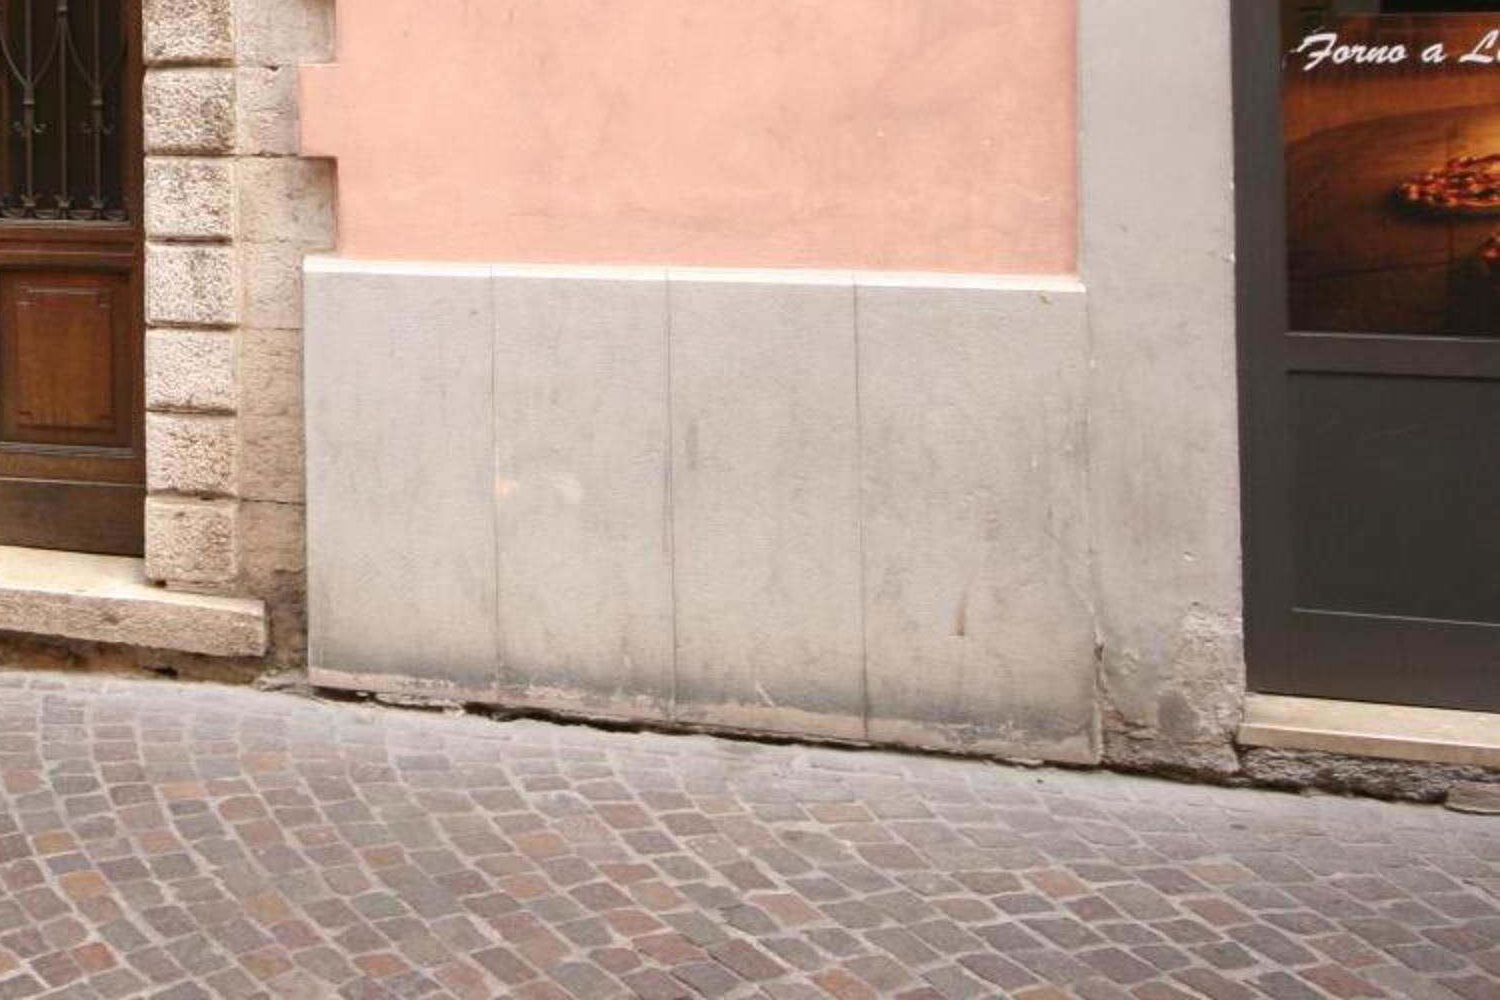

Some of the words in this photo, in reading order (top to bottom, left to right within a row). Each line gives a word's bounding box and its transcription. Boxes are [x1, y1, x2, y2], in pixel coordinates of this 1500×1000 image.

[1293, 30, 1408, 71] Forno
[1421, 43, 1447, 63] a
[1459, 29, 1500, 63] L
